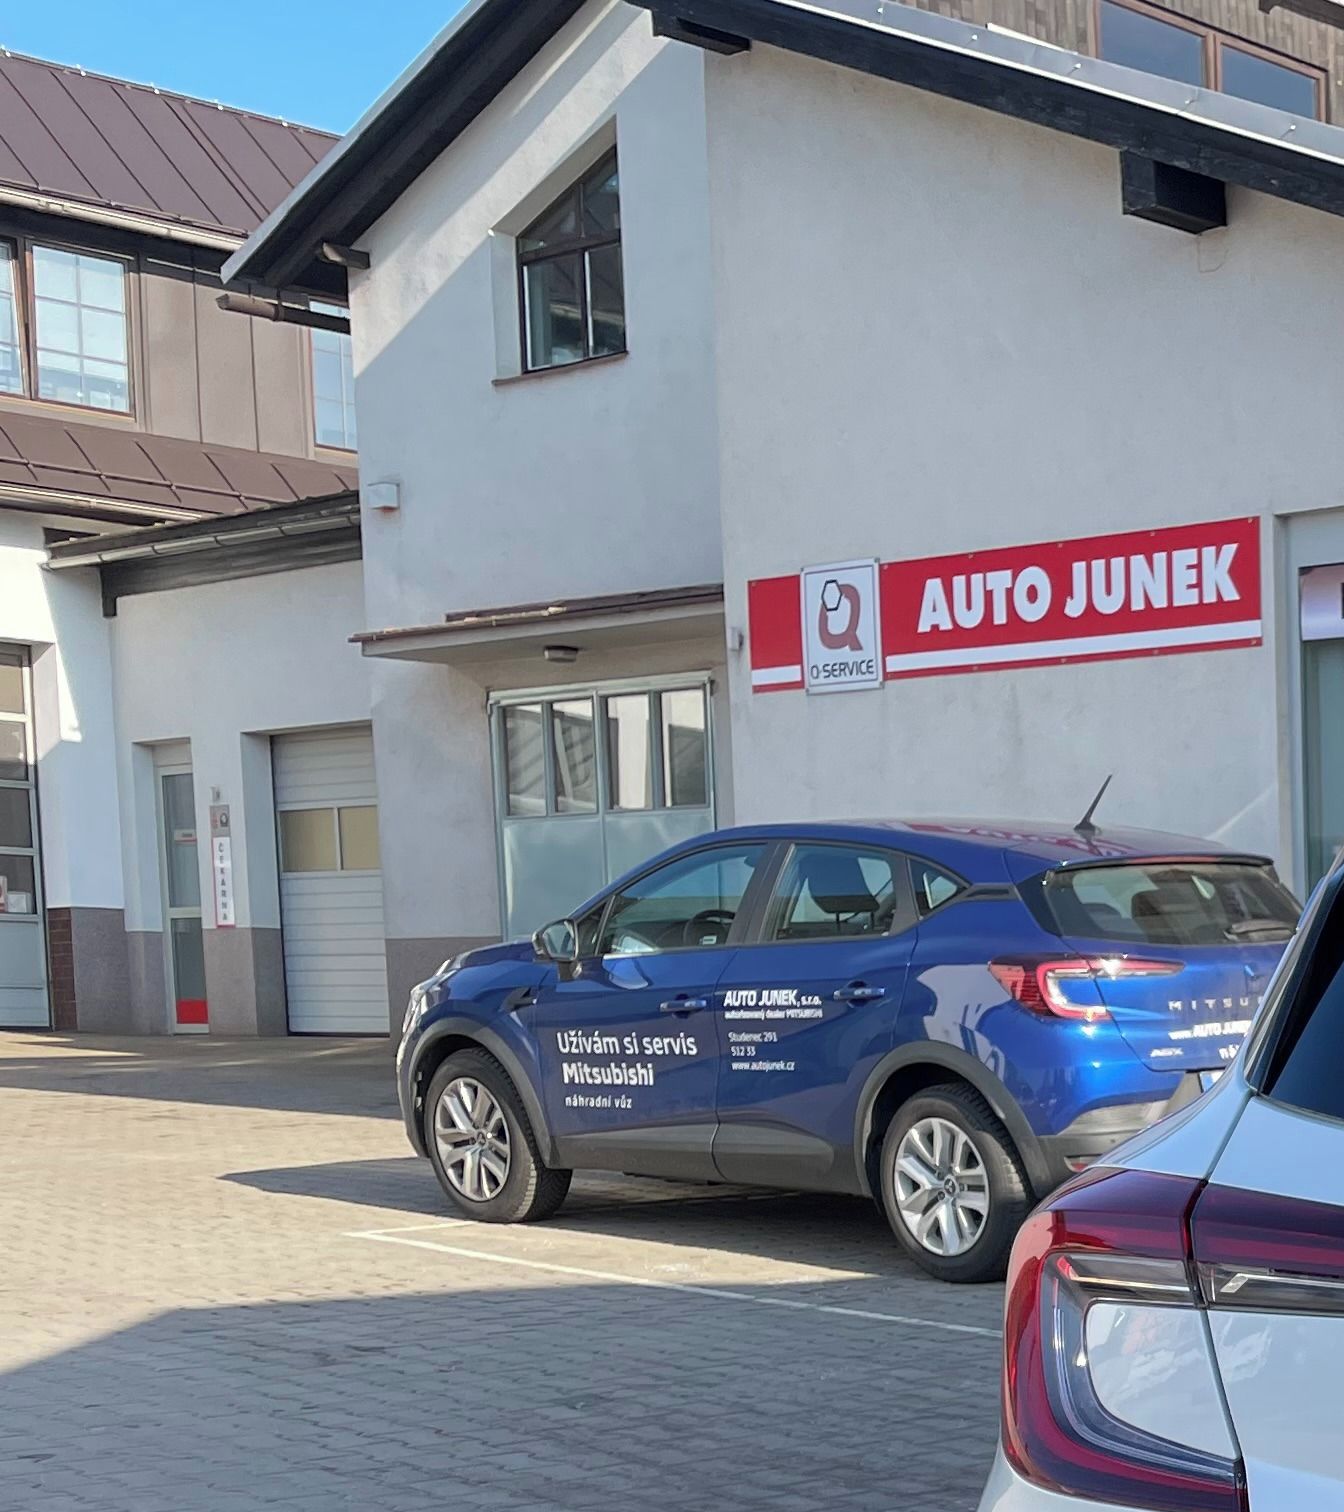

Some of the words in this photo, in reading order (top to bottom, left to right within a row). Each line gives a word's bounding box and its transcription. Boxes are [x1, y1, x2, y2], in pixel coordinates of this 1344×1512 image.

[917, 565, 1053, 634] AUTO
[1064, 542, 1242, 619] JUNEK
[723, 990, 757, 1008] AUTO
[556, 1030, 620, 1055] Užívám
[623, 1032, 639, 1055] si
[642, 1032, 698, 1056] servis
[562, 1062, 655, 1086] Mitsubishi
[731, 1060, 796, 1072] www.autojunek.cz
[565, 1094, 612, 1108] náhradní
[614, 1094, 632, 1109] vůz
